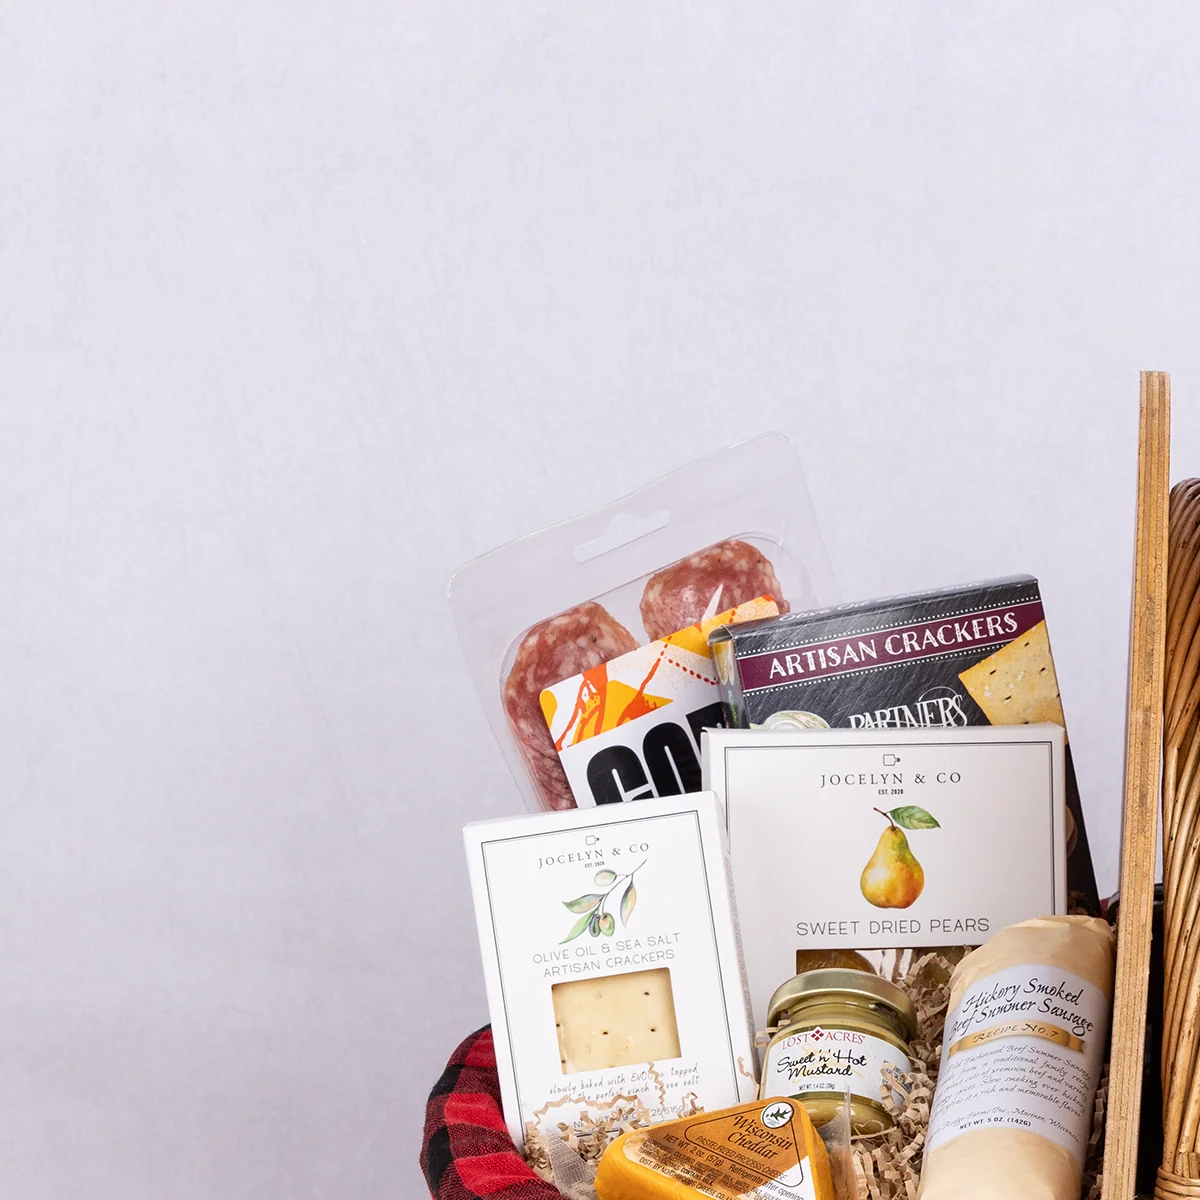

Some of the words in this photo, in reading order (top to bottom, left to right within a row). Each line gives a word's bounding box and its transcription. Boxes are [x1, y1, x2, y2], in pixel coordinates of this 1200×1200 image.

[770, 640, 876, 679] ARTISAN
[885, 612, 1018, 655] CRACKERS
[821, 773, 903, 788] JOCELYN
[915, 773, 925, 784] &
[937, 772, 961, 784] CO
[538, 849, 604, 869] JOCELYN
[612, 848, 620, 856] &
[629, 843, 649, 853] CO
[796, 922, 860, 936] SWEET
[869, 920, 921, 934] DRIED
[930, 918, 989, 933] PEARS
[533, 949, 570, 964] OLIVE
[575, 945, 596, 957] OIL
[601, 943, 610, 954] &
[616, 939, 642, 952] SEA
[647, 933, 680, 948] SALT
[544, 960, 600, 978] ARTISAN
[606, 950, 675, 968] CRACKERS
[963, 983, 1021, 1013] Hickory
[1023, 977, 1084, 1006] Smoked
[949, 1009, 978, 1041] Beef
[975, 1000, 1036, 1023] Summer
[1037, 998, 1094, 1037] Sausage
[782, 1033, 811, 1049] LOST
[825, 1032, 863, 1044] ACRES
[973, 1024, 1019, 1043] RECIPE
[777, 1051, 817, 1073] Sweet
[832, 1049, 867, 1066] Hot
[1005, 1045, 1027, 1053] Beef
[1027, 1047, 1062, 1062] Summer
[549, 1084, 576, 1094] slowly
[581, 1078, 604, 1090] baked
[608, 1073, 626, 1085] with
[670, 1063, 698, 1076] topped
[788, 1065, 853, 1080] Mustard
[993, 1056, 1038, 1065] traditional
[1041, 1060, 1068, 1077] family
[1029, 1066, 1045, 1078] beef
[1047, 1073, 1063, 1084] and
[628, 1084, 650, 1094] pinch
[684, 1075, 700, 1086] salt
[980, 1086, 996, 1094] rich
[1018, 1087, 1059, 1103] memorable
[1004, 1075, 1038, 1089] smoking
[1041, 1083, 1060, 1093] over
[733, 1115, 794, 1150] Wisconsin
[959, 1121, 972, 1130] NET
[1007, 1117, 1032, 1127] (142G)
[727, 1132, 778, 1160] Cheddar
[663, 1133, 678, 1145] NET
[677, 1140, 691, 1151] WT.
[705, 1154, 724, 1168] (57g)
[728, 1163, 763, 1186] Refrigerate
[763, 1179, 779, 1192] after
[694, 1135, 736, 1158] PASTEURIZED
[734, 1152, 764, 1171] PROCESS
[763, 1166, 788, 1182] CHEESE
[652, 1163, 661, 1171] BY
[695, 1183, 716, 1196] CHEESE
